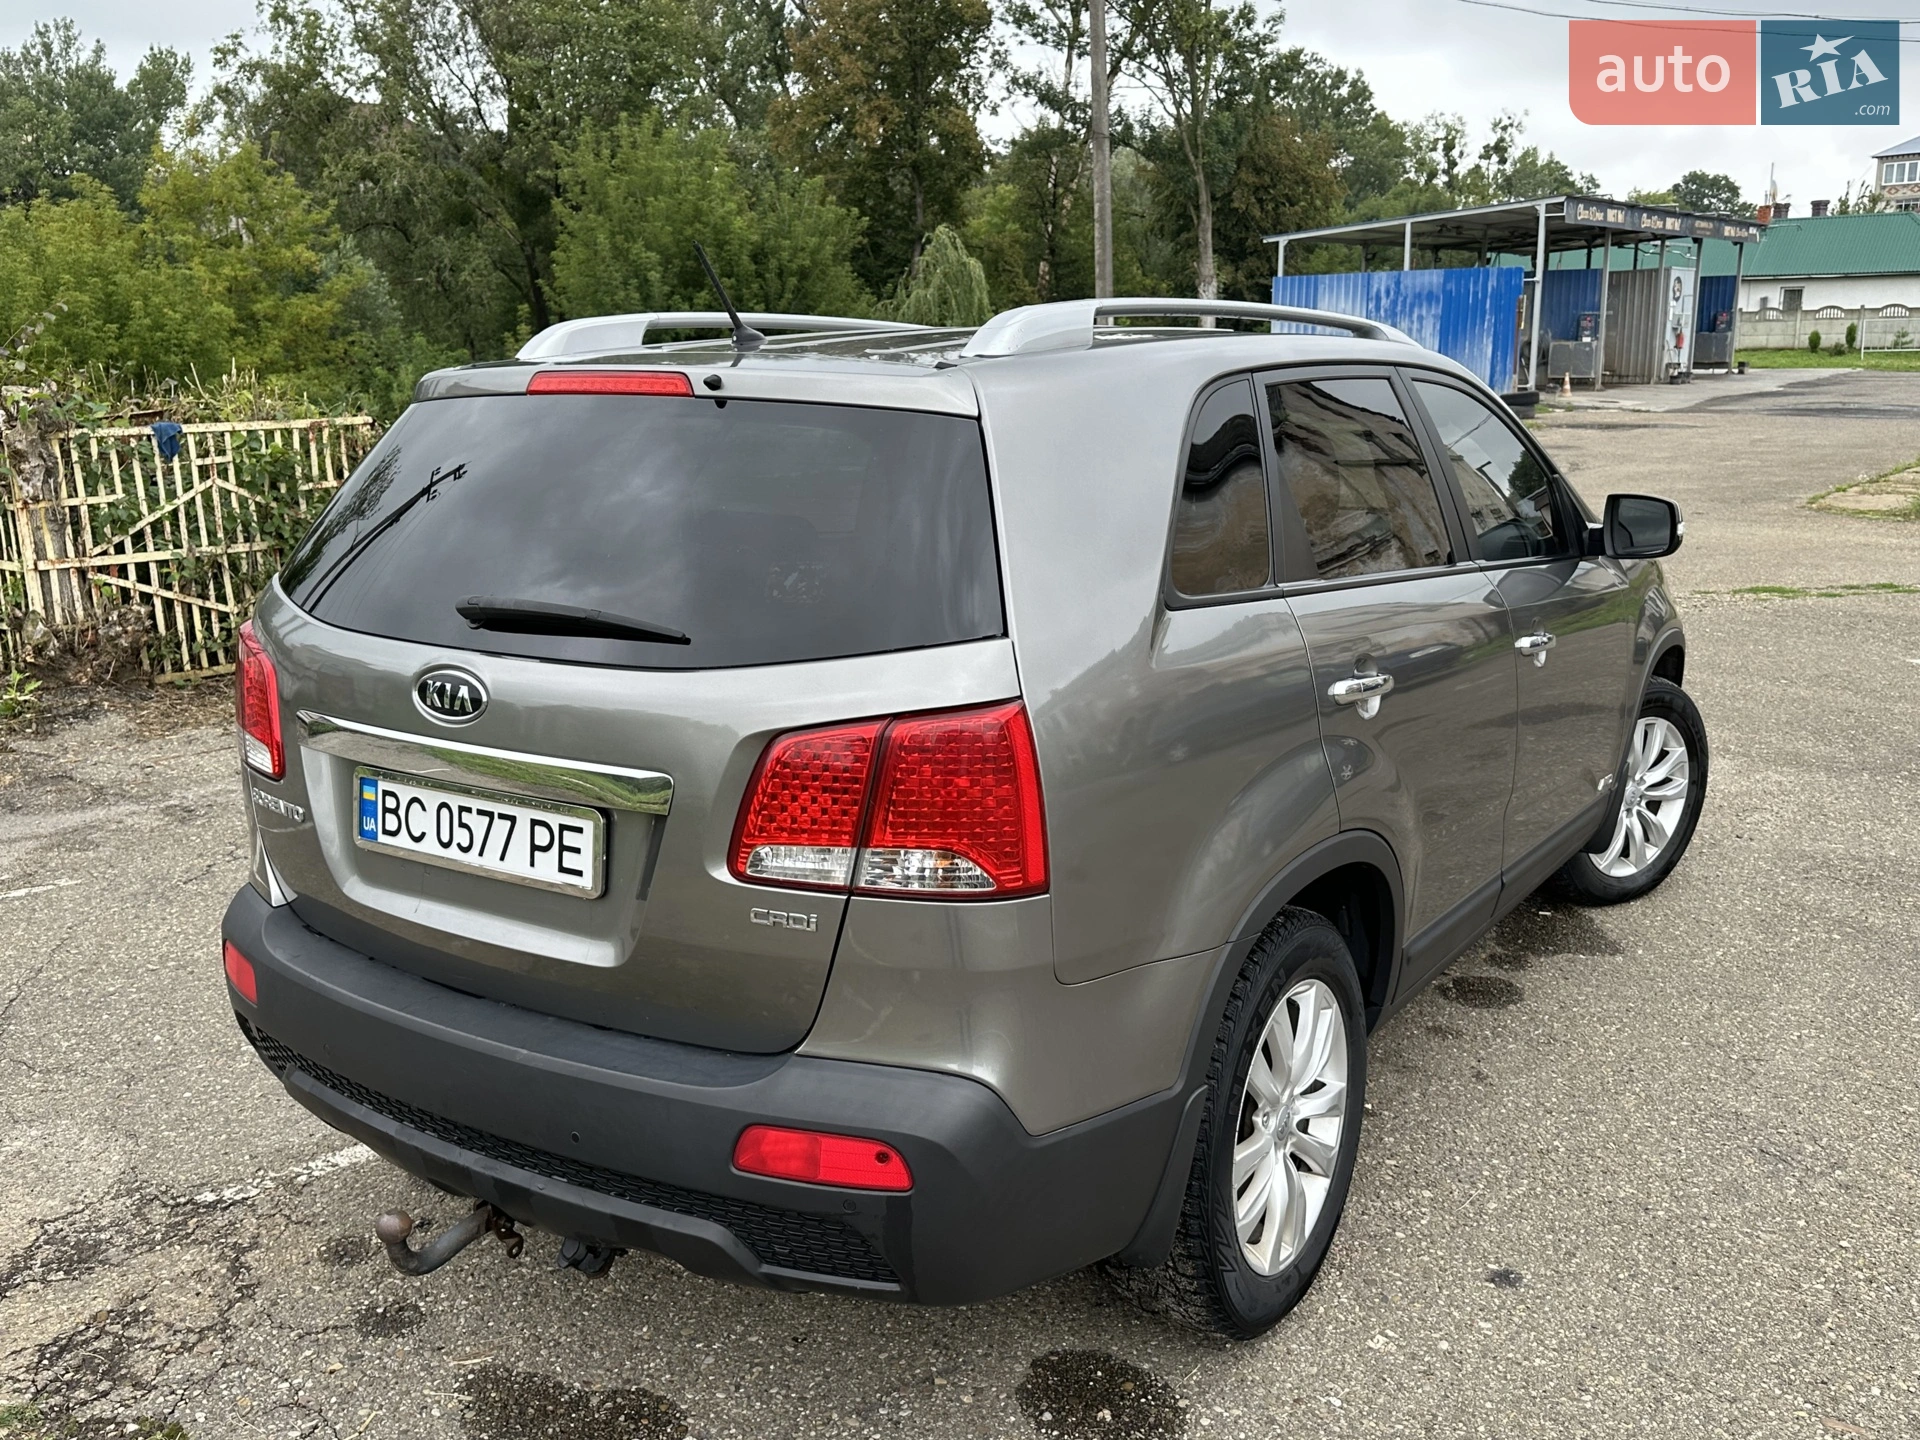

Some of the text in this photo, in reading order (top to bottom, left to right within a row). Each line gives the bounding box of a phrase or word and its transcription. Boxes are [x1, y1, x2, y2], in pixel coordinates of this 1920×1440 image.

[426, 680, 473, 712] KIA
[363, 816, 377, 833] UA
[381, 789, 584, 877] BC 0577 PE
[750, 907, 818, 932] CRDi
[1227, 967, 1287, 1116] NEXEN
